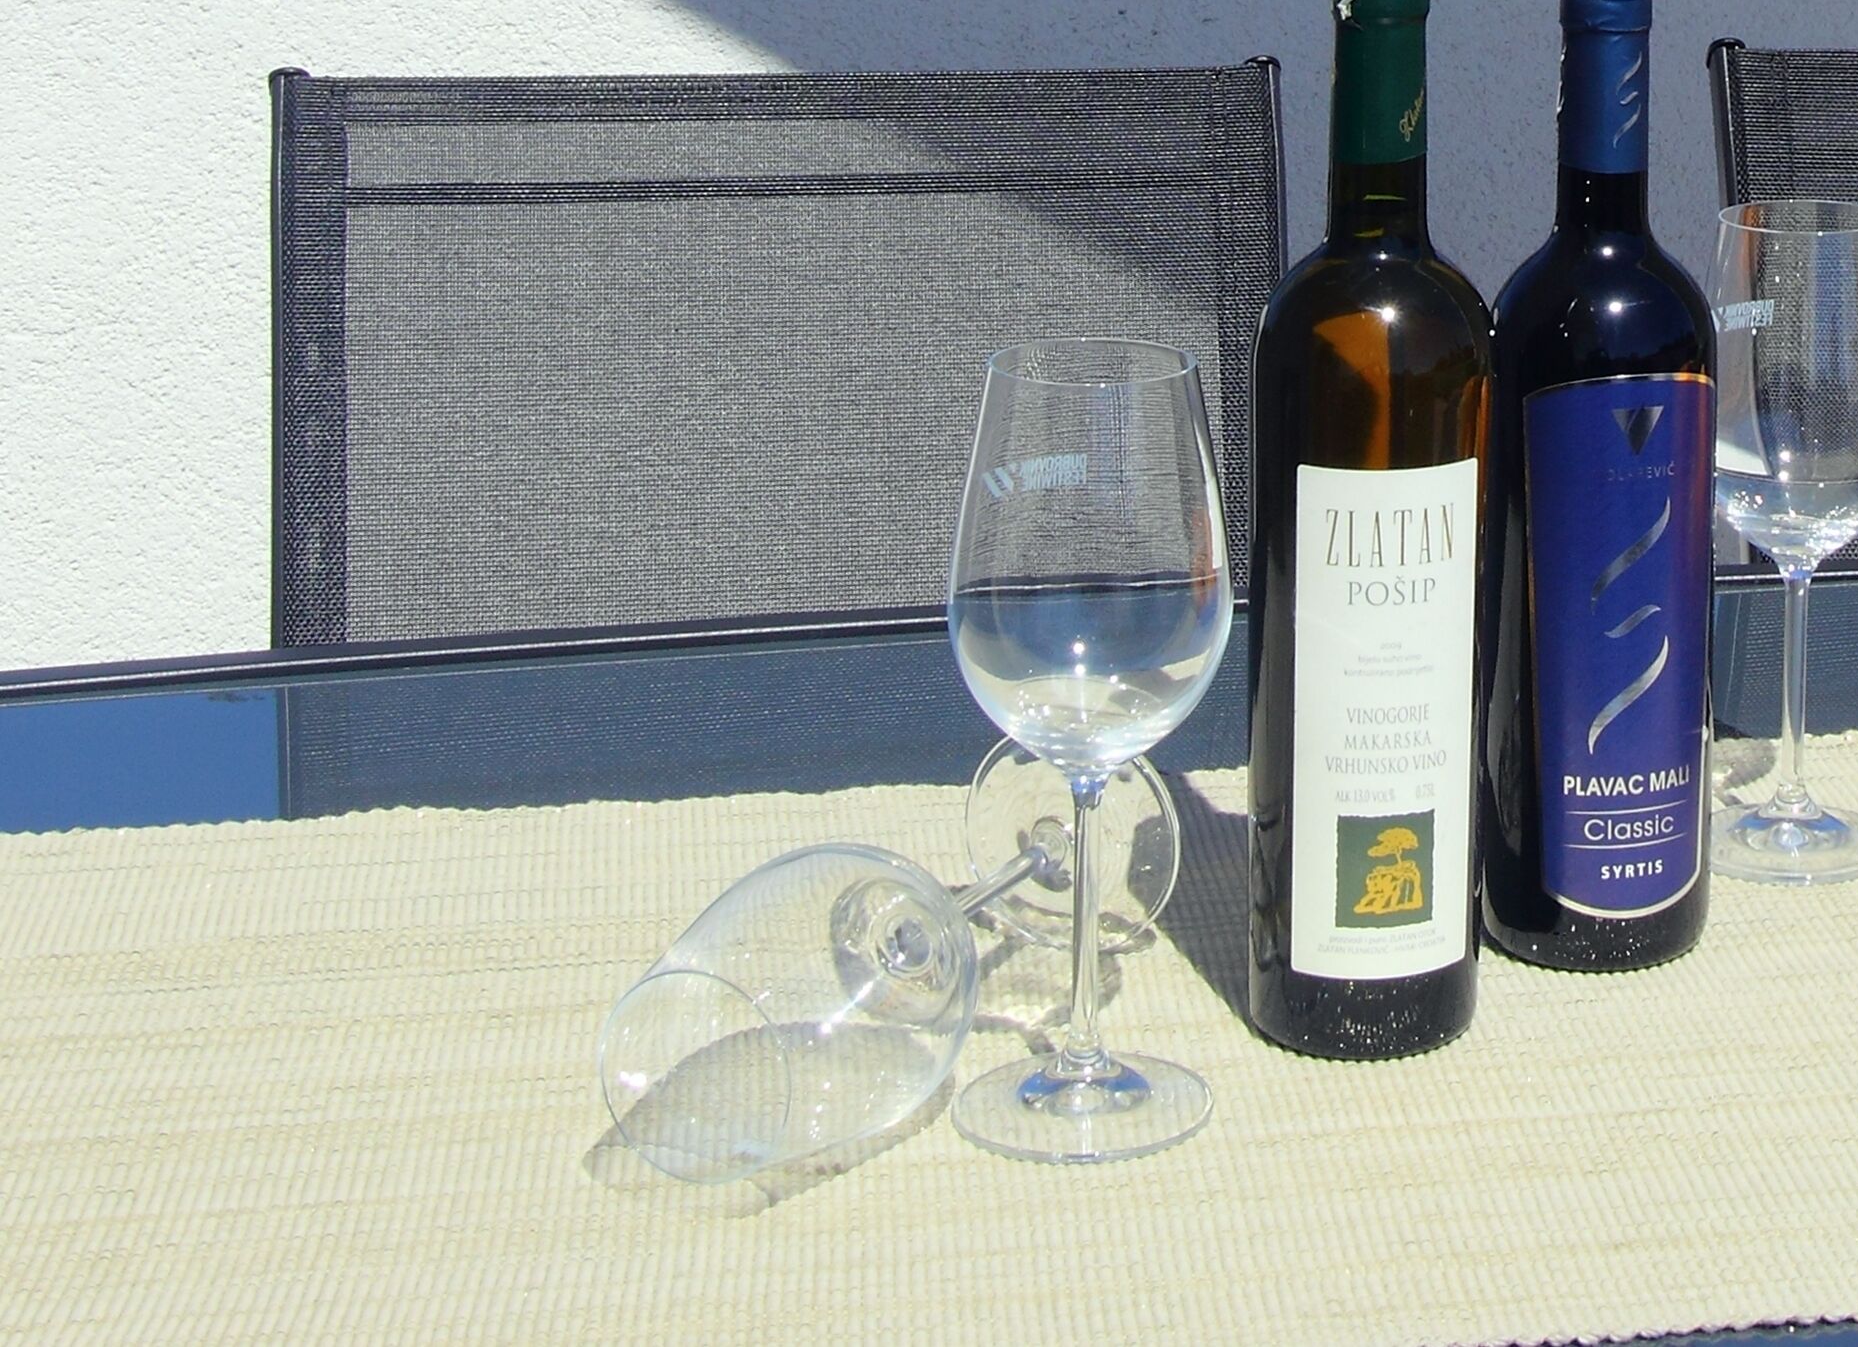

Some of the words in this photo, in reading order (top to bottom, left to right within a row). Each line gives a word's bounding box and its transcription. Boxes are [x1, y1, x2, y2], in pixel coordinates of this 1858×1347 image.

[1326, 503, 1454, 568] ZLATAN
[1347, 575, 1436, 606] POŠIP
[1346, 703, 1430, 725] VINOGORJE
[1344, 730, 1431, 750] MAKARSKA
[1325, 755, 1409, 774] VRHUNSKO
[1413, 750, 1447, 770] VINO
[1563, 775, 1645, 796] PLAVAC
[1649, 764, 1689, 792] MALI
[1584, 814, 1674, 841] Classic
[1601, 859, 1663, 879] SYRTIS
